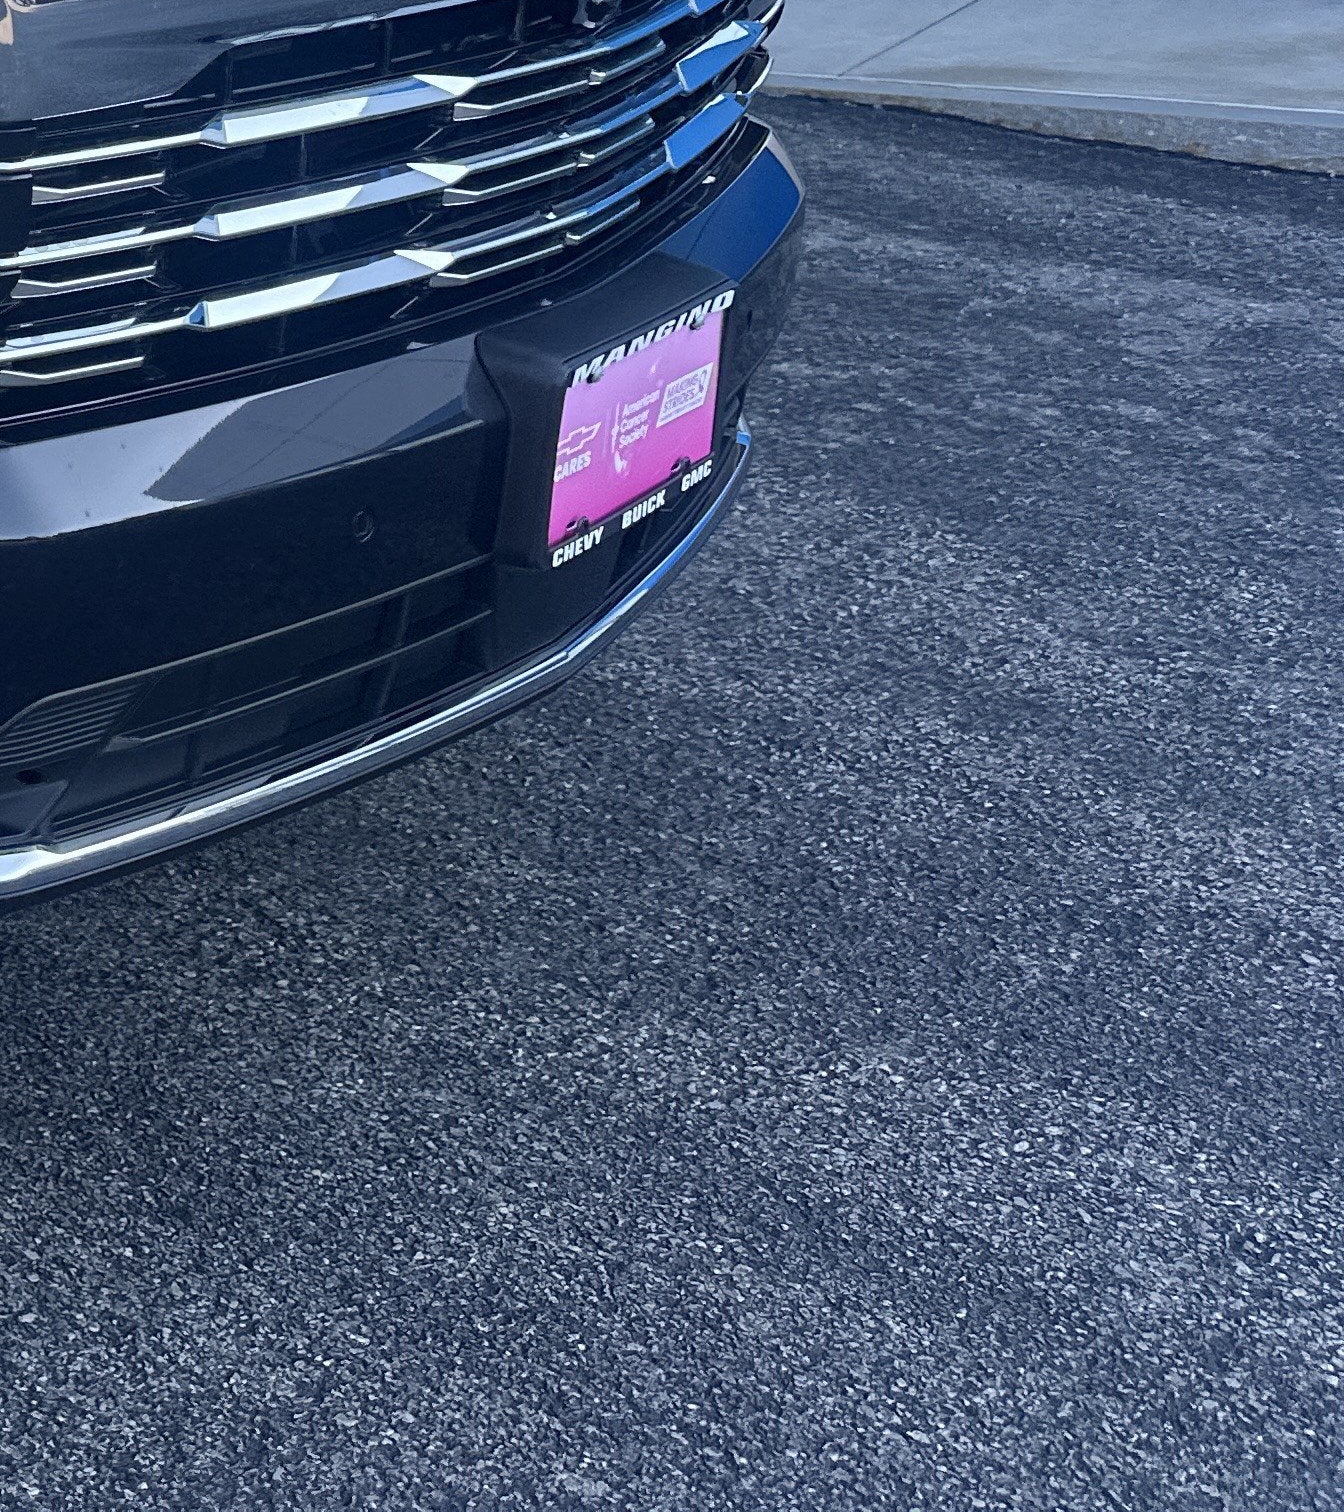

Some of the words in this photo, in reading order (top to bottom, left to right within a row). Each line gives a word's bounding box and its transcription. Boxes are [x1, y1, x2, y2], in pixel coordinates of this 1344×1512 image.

[572, 289, 735, 388] MANGINO
[552, 526, 605, 568] CHEVY
[621, 489, 667, 530] BUICK
[680, 459, 713, 492] GMC
[553, 451, 592, 483] CARES
